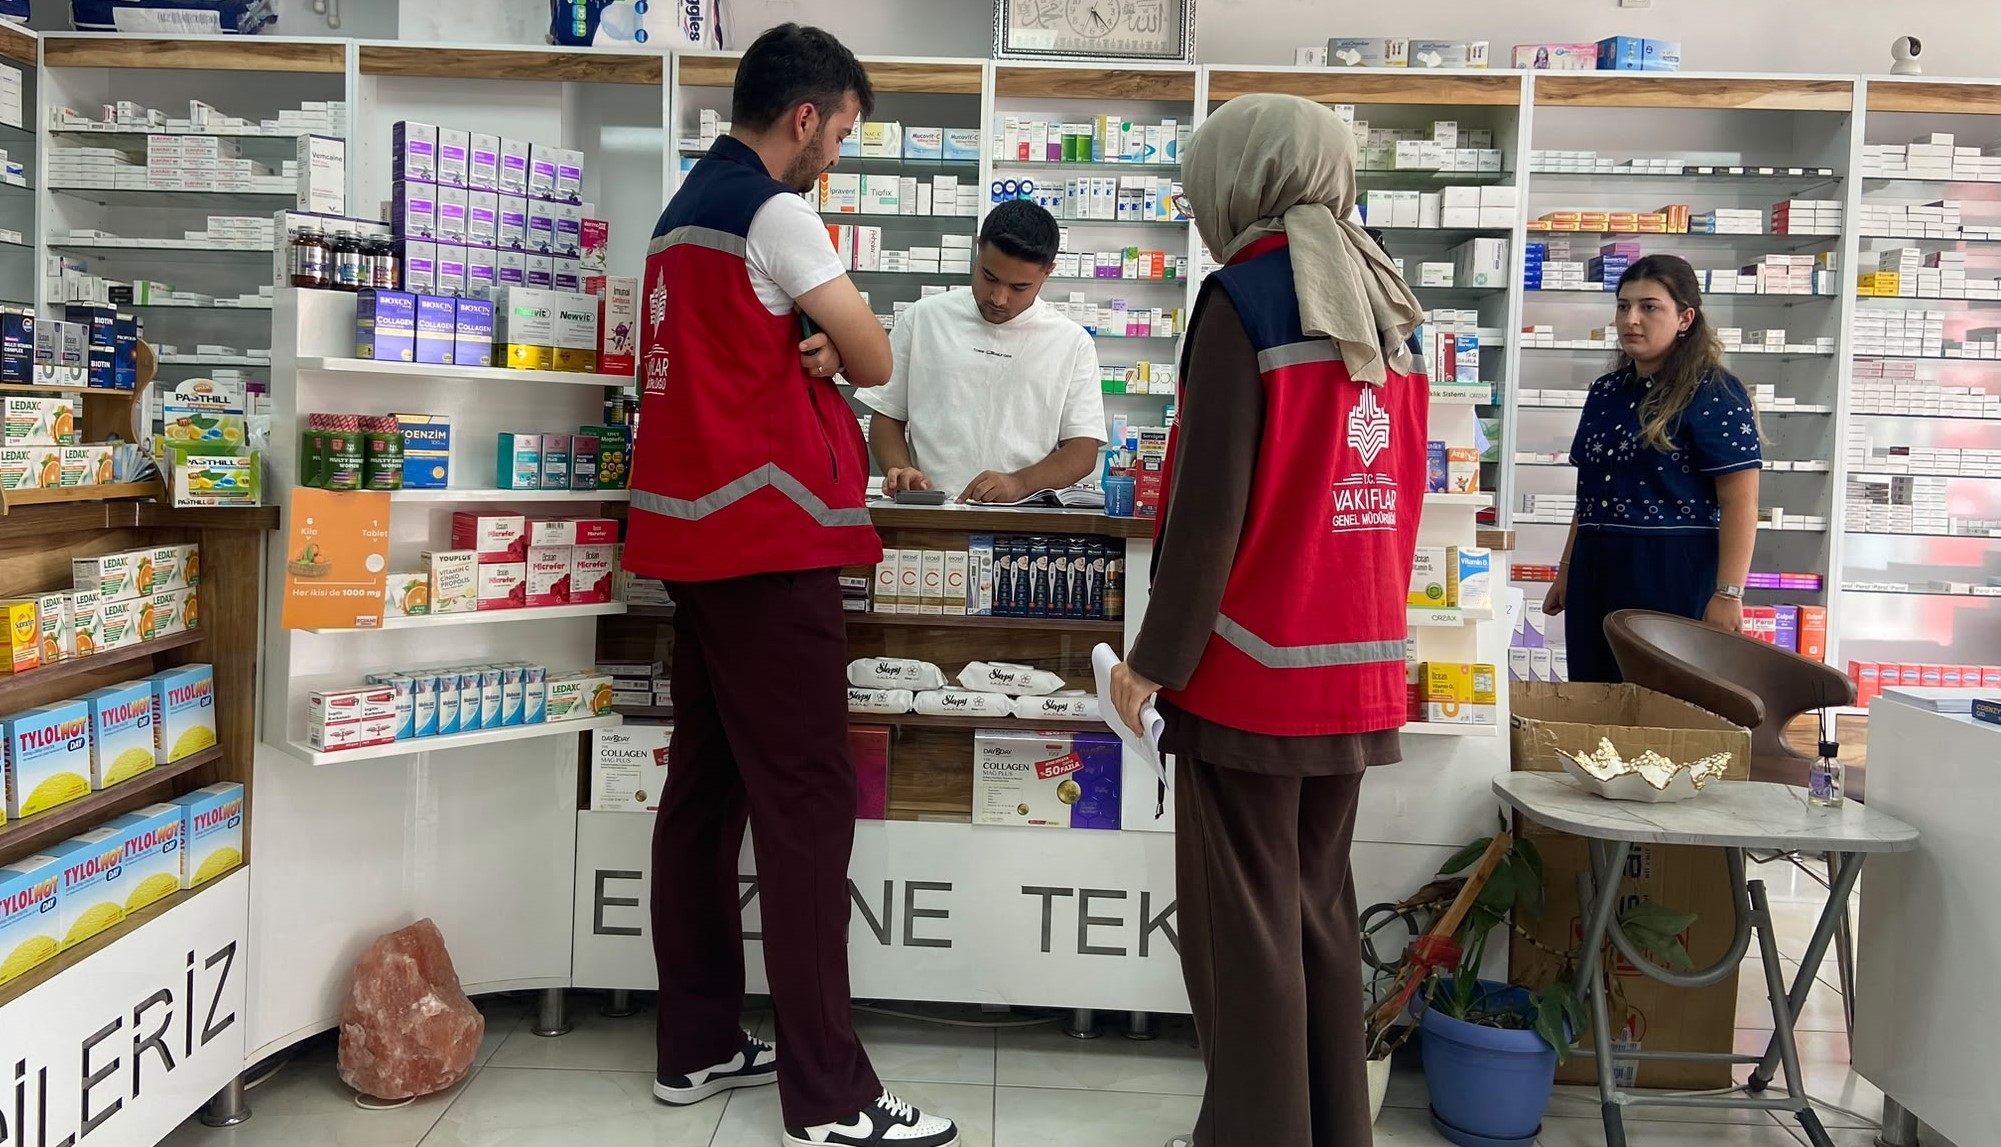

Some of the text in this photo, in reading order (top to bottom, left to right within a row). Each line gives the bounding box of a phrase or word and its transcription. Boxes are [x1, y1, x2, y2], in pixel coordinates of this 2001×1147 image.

[871, 188, 892, 196] Tiofix
[380, 296, 412, 306] BIOXCIN
[422, 300, 452, 310] BIOXCIN
[460, 304, 490, 313] BIOXCIN
[515, 307, 546, 318] vit
[94, 316, 114, 326] BIOTIN
[376, 316, 414, 326] COLLAGEN
[560, 310, 591, 322] Newvit
[418, 320, 454, 330] COLLAGEN
[457, 322, 491, 332] COLLAGEN
[90, 360, 110, 369] BIOTIN
[1363, 473, 1376, 484] T.C.
[1332, 488, 1397, 511] VAKIFLAR
[1332, 514, 1358, 526] GENEL
[362, 529, 388, 537] Tablet
[488, 530, 515, 538] Microfer
[533, 562, 565, 571] Microfer
[576, 560, 608, 569] Microfer
[440, 567, 463, 576] VITAMIN
[880, 570, 894, 584] C
[902, 571, 916, 585] C
[925, 572, 939, 586] C
[948, 572, 962, 586] C
[441, 577, 470, 588] PROPOLIS
[202, 697, 211, 706] DAY
[139, 716, 149, 727] DAY
[70, 739, 83, 750] DAY
[601, 749, 647, 758] COLLAGEN
[983, 762, 1030, 771] COLLAGEN
[1060, 762, 1080, 773] FAZLA
[229, 818, 239, 828] DAY
[164, 842, 176, 852] DAY
[108, 868, 120, 880] DAY
[42, 899, 54, 912] DAY
[0, 940, 236, 1147] İLERİZ
